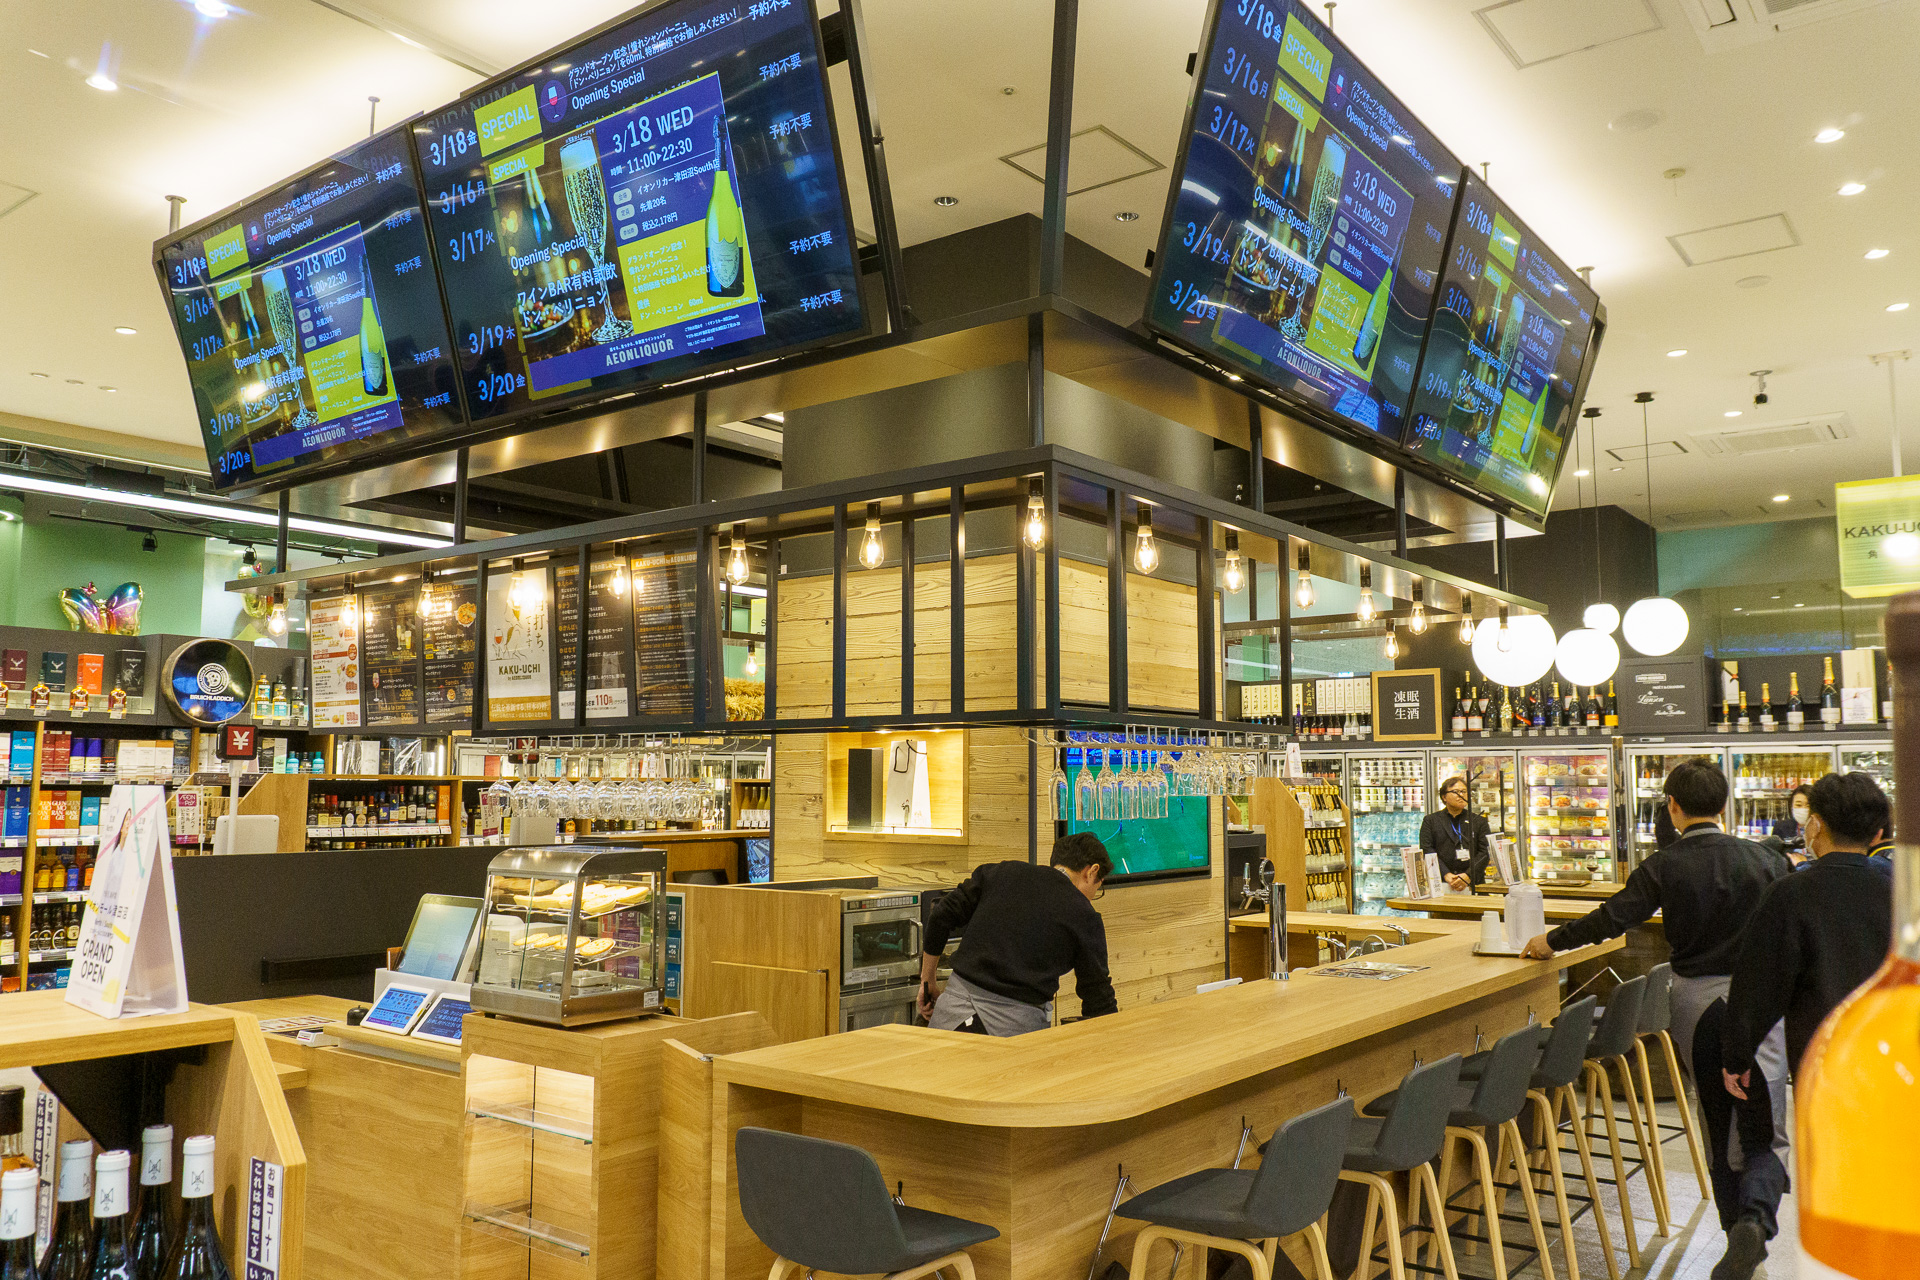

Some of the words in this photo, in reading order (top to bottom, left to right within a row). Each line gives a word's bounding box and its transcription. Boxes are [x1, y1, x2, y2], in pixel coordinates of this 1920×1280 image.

[759, 52, 802, 81] 予約不要
[1285, 34, 1325, 84] SPECIAL
[571, 84, 610, 111] Opening
[611, 67, 646, 94] Special
[1277, 86, 1304, 119] SPECIAL
[481, 104, 534, 139] SPECIAL
[612, 115, 652, 153] 3/18
[656, 105, 694, 136] WED
[769, 112, 812, 140] 予約不要
[1346, 105, 1370, 136] Opening
[1368, 125, 1389, 152] Special
[493, 156, 529, 180] SPECIAL
[1353, 170, 1378, 201] 3/18
[1376, 189, 1397, 218] WED
[1254, 186, 1286, 224] Opening
[1286, 207, 1314, 238] Special
[266, 227, 291, 245] Opening
[291, 215, 314, 234] Special
[789, 231, 833, 255] 予約不要
[208, 238, 244, 265] SPECIAL
[295, 252, 321, 280] 3/18
[322, 246, 347, 269] WED
[511, 247, 550, 270] Opening
[551, 231, 588, 256] Special
[218, 280, 242, 298] SPECIAL
[800, 289, 843, 313] 予約不要
[1527, 315, 1543, 337] 3/18
[1542, 326, 1555, 345] WED
[234, 350, 261, 370] Opening
[260, 342, 285, 361] Special
[414, 346, 441, 364] 予約不要
[606, 338, 674, 367] AEONLIQUOR
[1277, 347, 1322, 379] AEONLIQUOR
[1468, 339, 1487, 363] Opening
[302, 427, 346, 448] AEONLIQUOR
[190, 694, 234, 702] BRUICHLADDICH
[1394, 690, 1420, 703] 凍眠
[1394, 708, 1420, 720] 生酒
[83, 938, 113, 963] GRAND
[81, 960, 106, 984] OPEN
